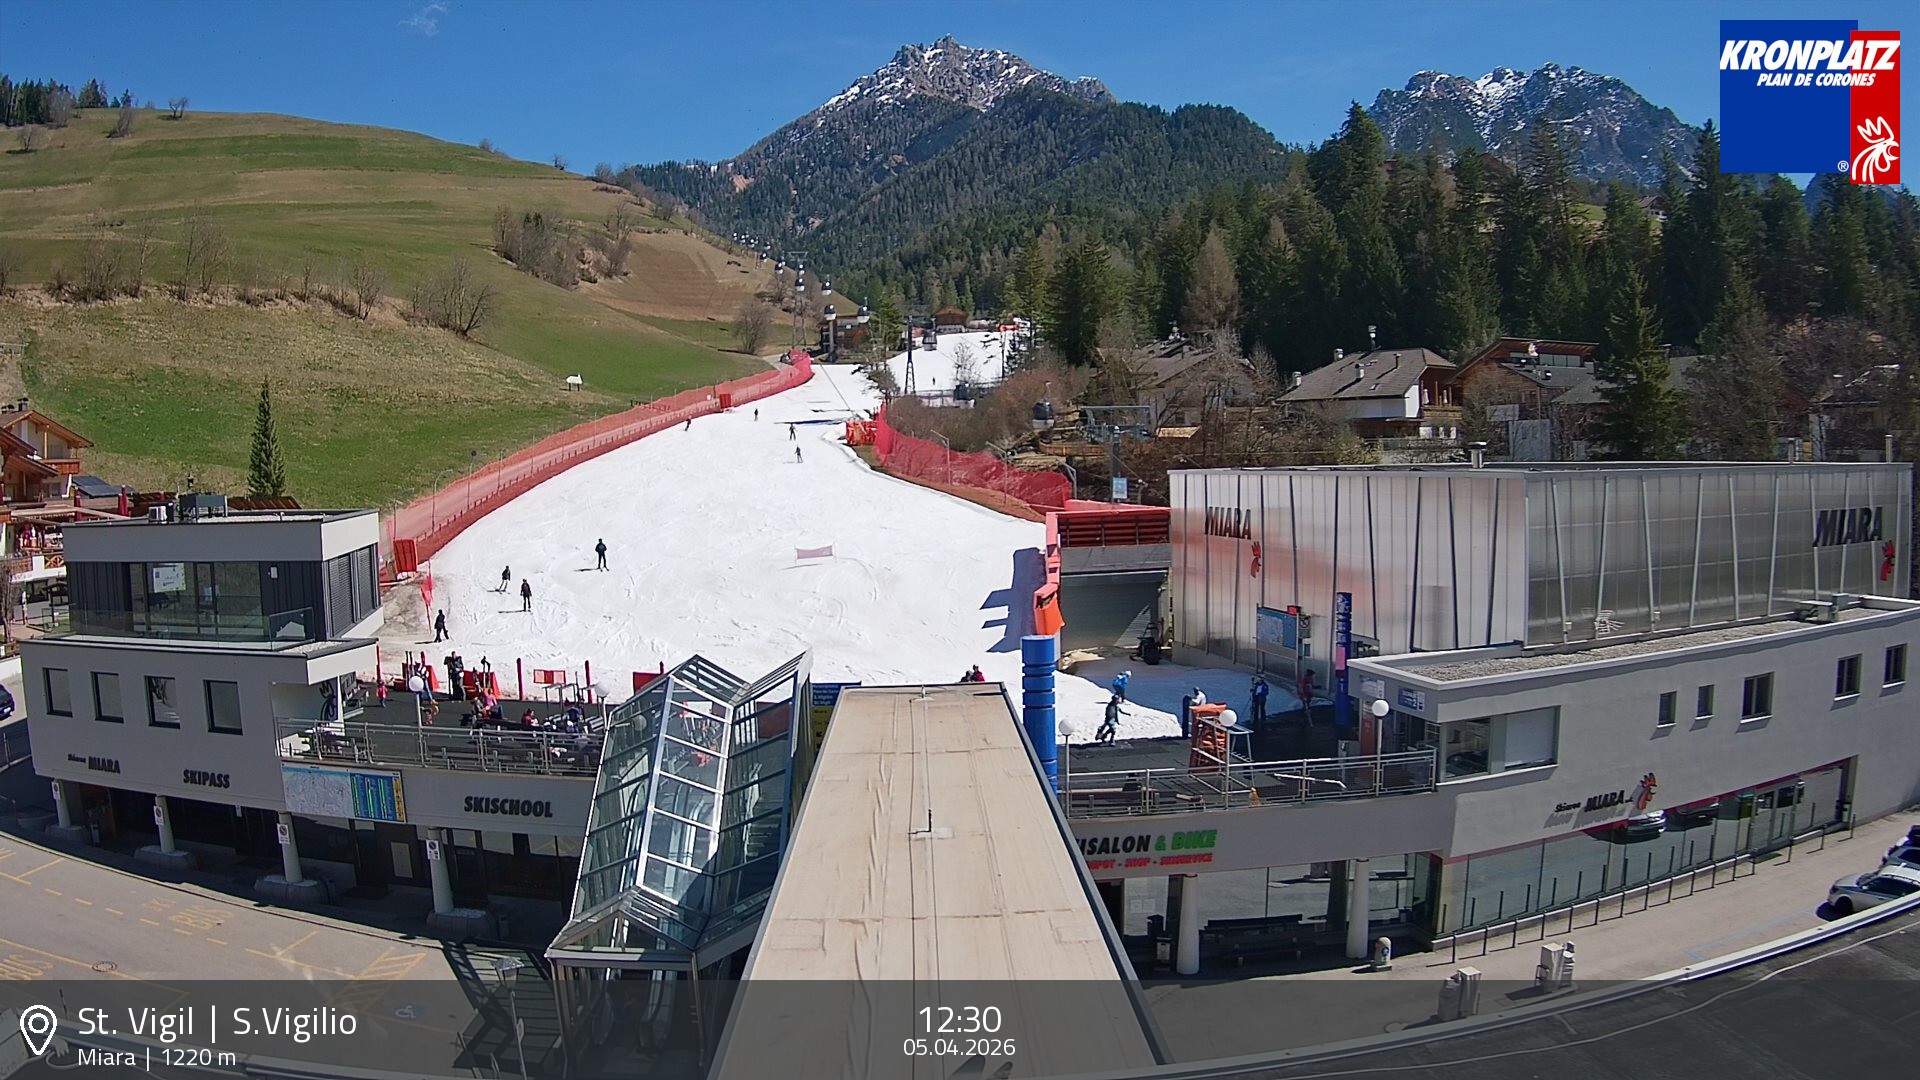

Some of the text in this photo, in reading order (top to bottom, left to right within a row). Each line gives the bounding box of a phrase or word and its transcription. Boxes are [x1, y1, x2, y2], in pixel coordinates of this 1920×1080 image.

[1204, 506, 1251, 540] MIARA
[1812, 506, 1883, 547] MIARA
[88, 755, 121, 774] MIARA
[183, 769, 230, 789] SKIPASS
[464, 796, 553, 818] SKISCHOOL
[1584, 789, 1625, 812] MIARA
[1155, 835, 1167, 851] &
[1171, 830, 1218, 850] BIKE
